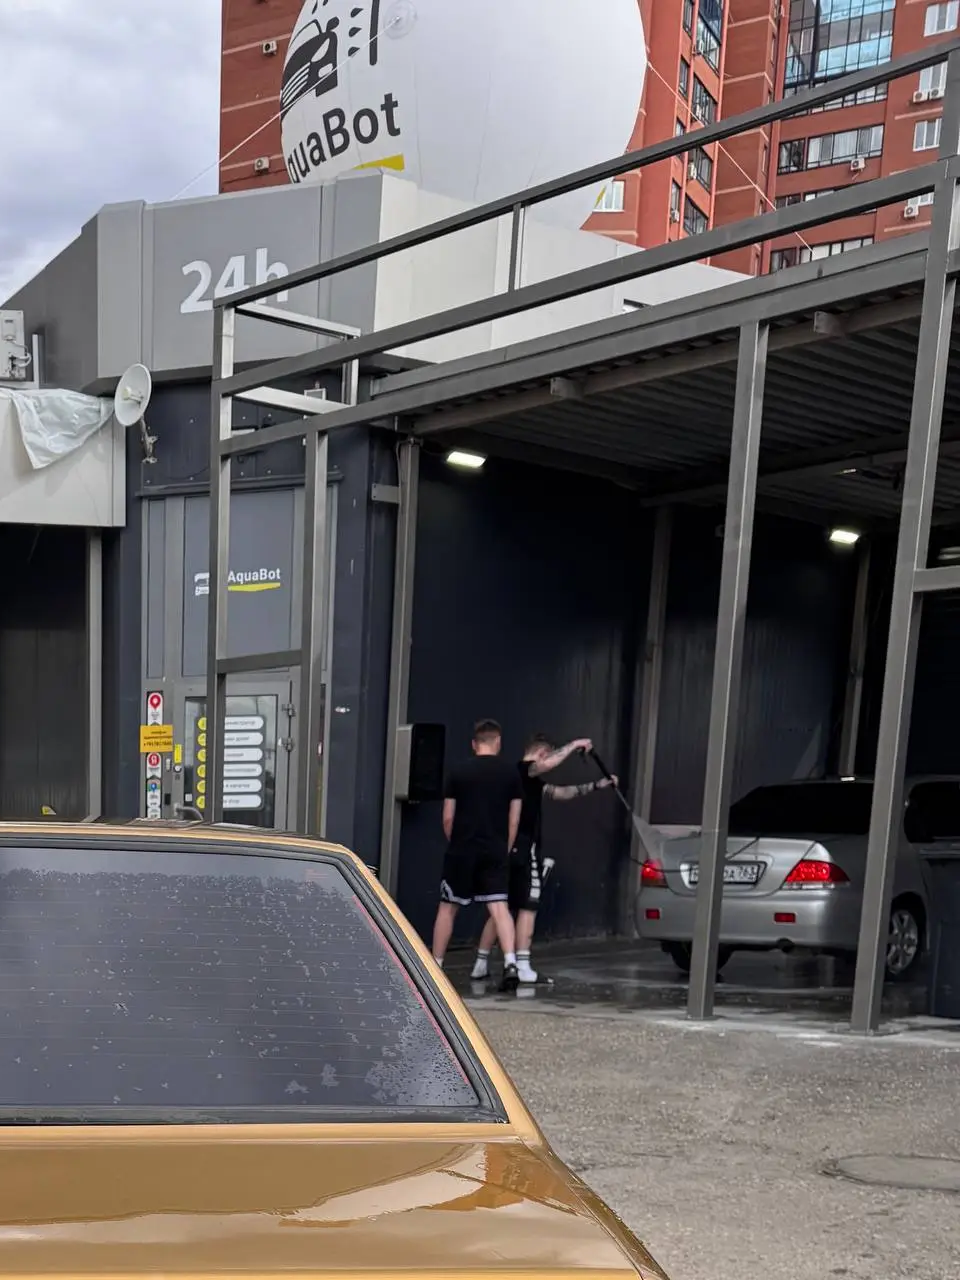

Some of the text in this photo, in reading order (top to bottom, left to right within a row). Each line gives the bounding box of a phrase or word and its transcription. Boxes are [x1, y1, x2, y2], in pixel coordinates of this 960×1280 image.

[288, 93, 401, 184] quaBot
[181, 248, 289, 313] 24h
[227, 568, 281, 584] AquaBot
